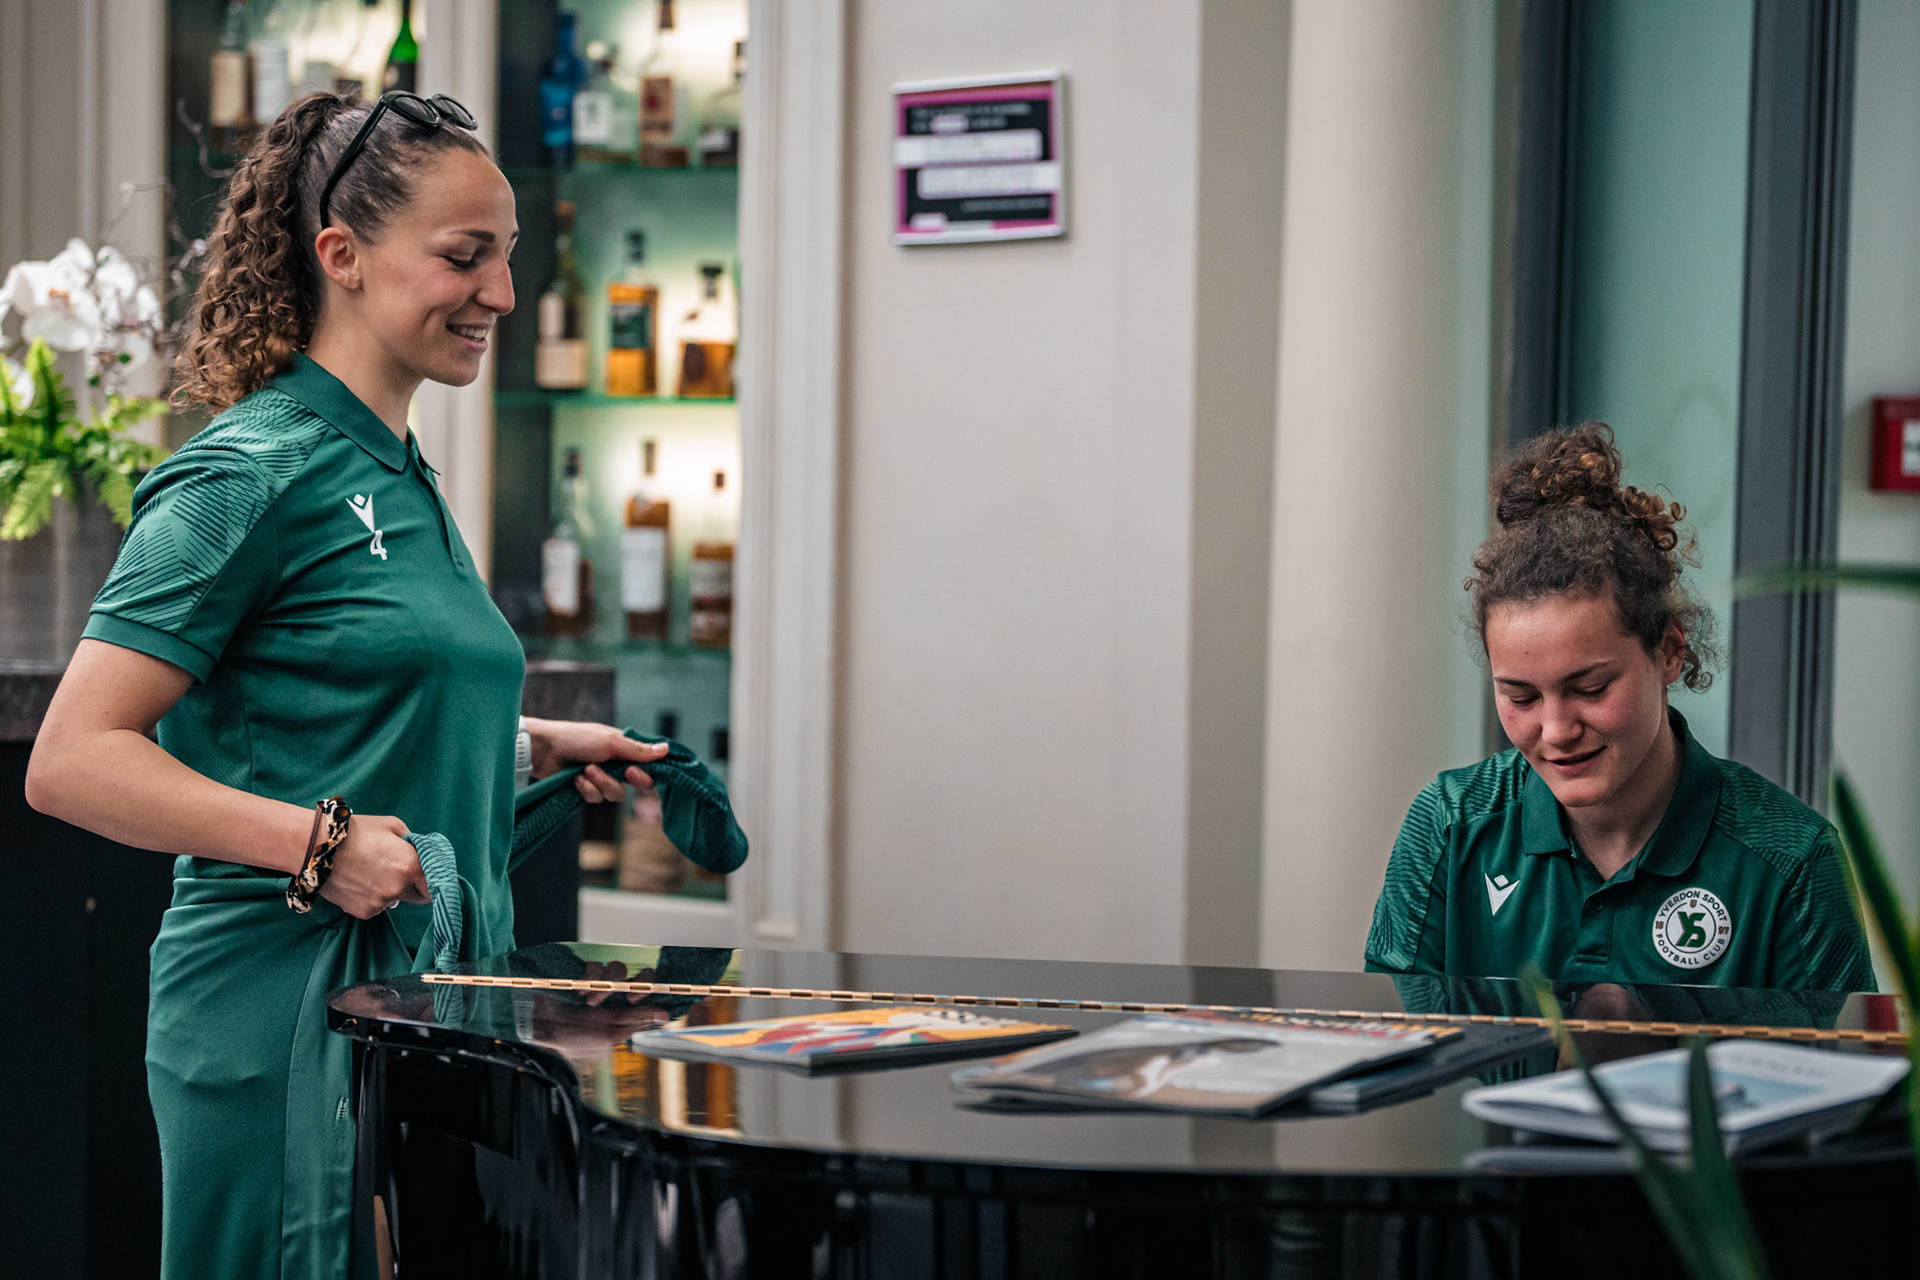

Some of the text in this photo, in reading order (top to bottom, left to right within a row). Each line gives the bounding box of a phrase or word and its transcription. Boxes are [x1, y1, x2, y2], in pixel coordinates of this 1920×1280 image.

[369, 529, 388, 561] 4
[1659, 890, 1728, 922] YVERDON SPORT
[1718, 926, 1730, 935] 97
[1656, 933, 1725, 965] FOOTBALL CLUB
